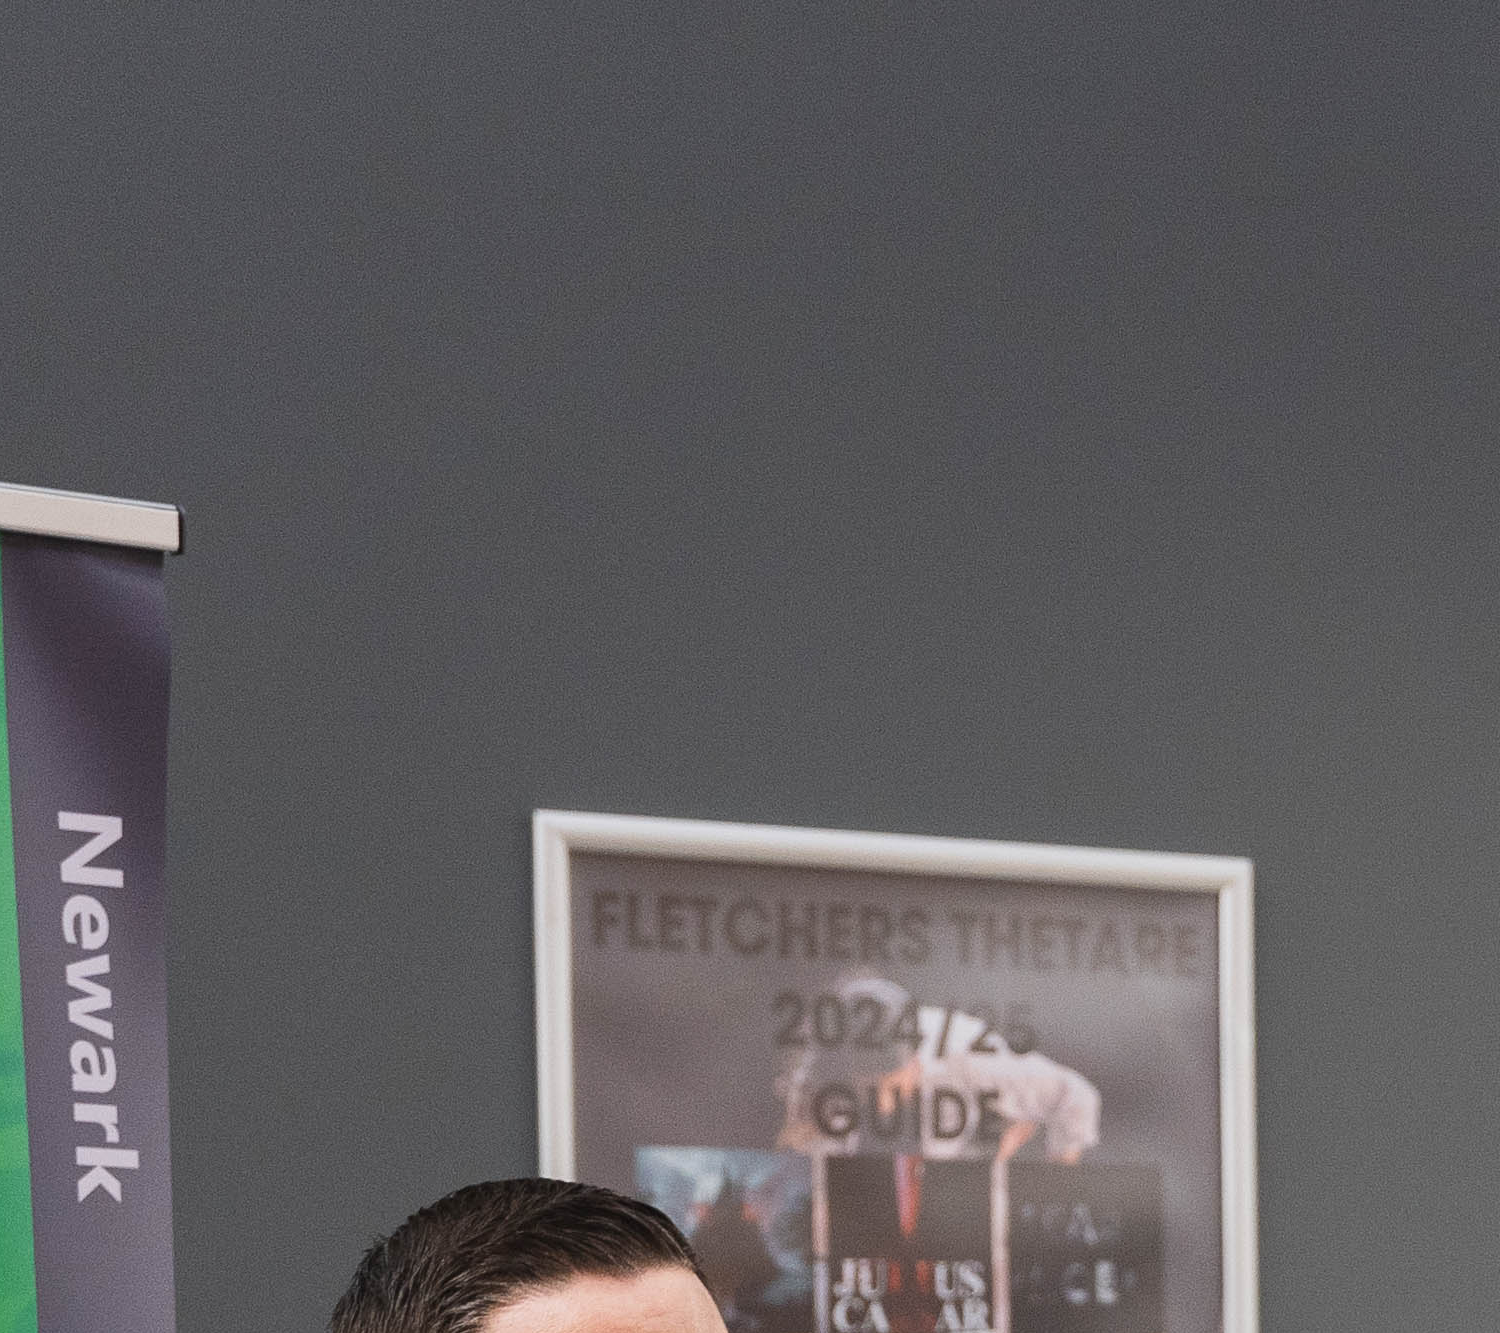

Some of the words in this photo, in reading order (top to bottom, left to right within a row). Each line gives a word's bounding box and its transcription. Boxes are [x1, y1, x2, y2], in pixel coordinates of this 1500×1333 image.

[591, 888, 934, 966] FLETCHERS
[57, 810, 140, 1203] Newark
[811, 1083, 1002, 1143] GUIDE
